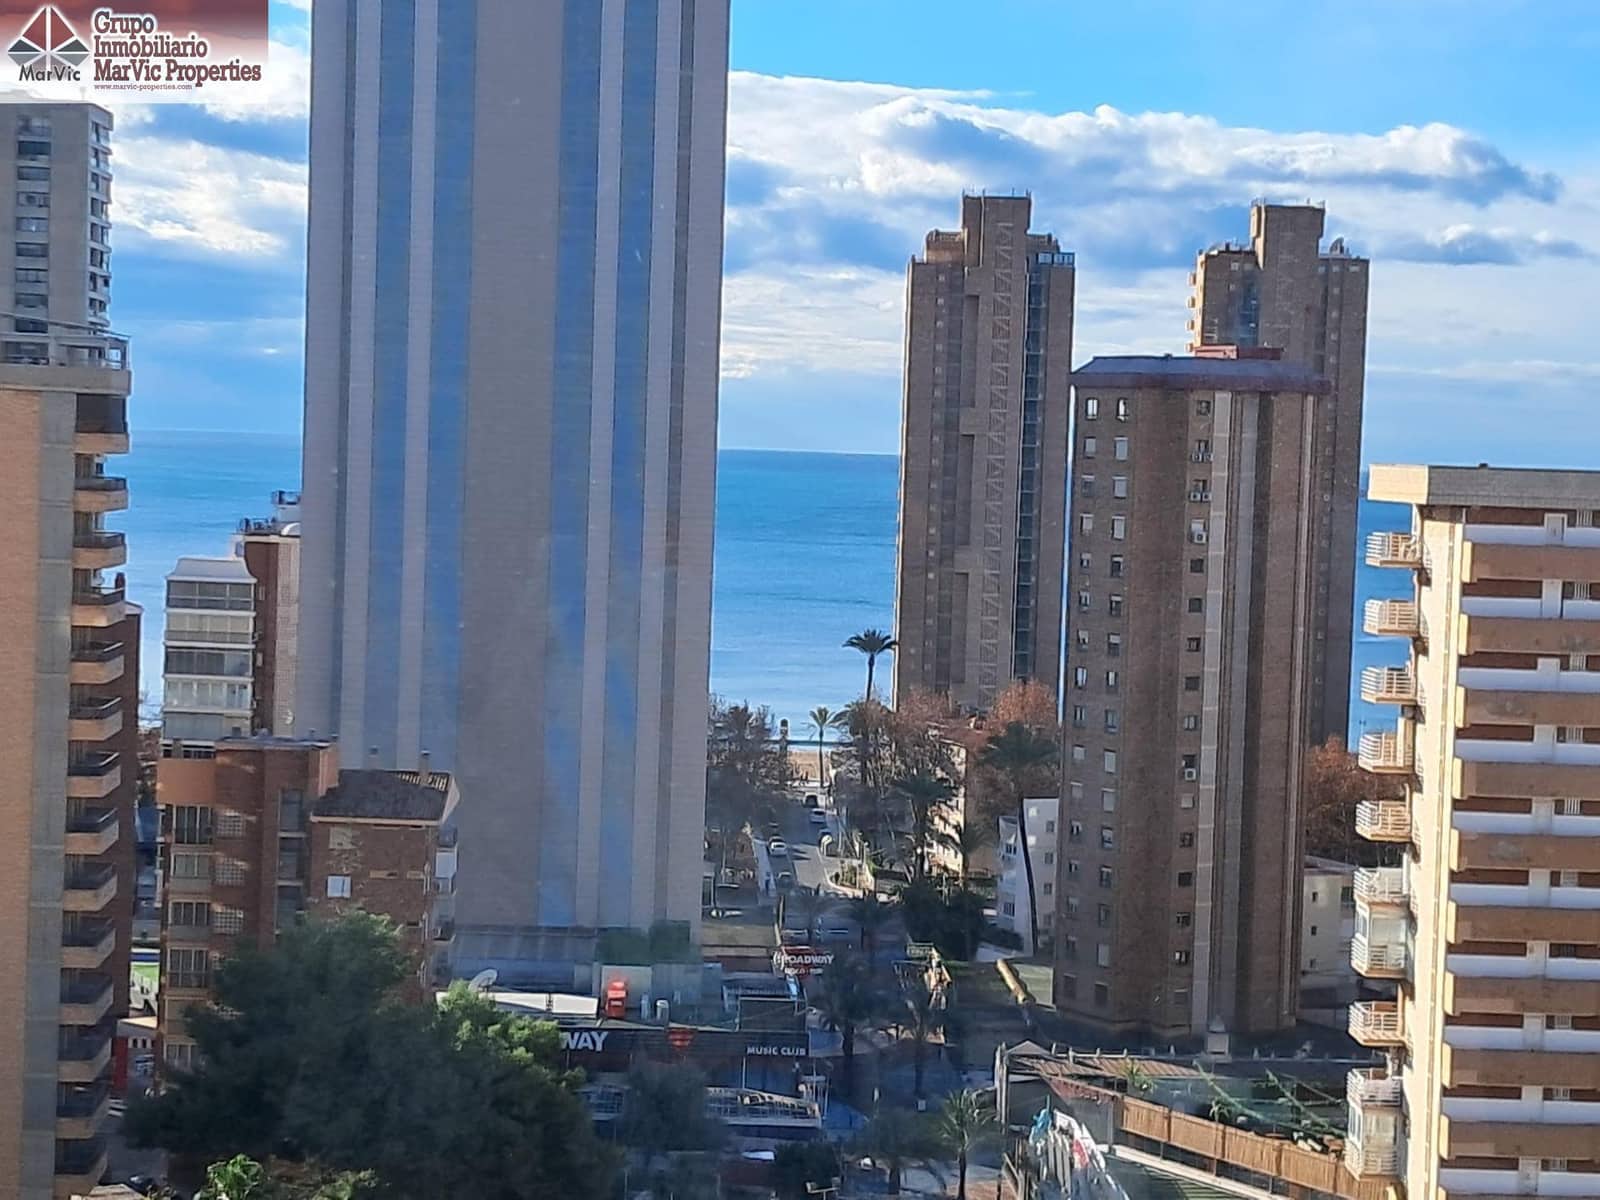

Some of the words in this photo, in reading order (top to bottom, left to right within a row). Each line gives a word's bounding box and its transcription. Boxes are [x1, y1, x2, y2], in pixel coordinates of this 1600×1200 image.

[559, 1031, 609, 1051] WAY
[747, 1046, 779, 1056] MUSIC
[780, 1047, 807, 1057] CLUB
